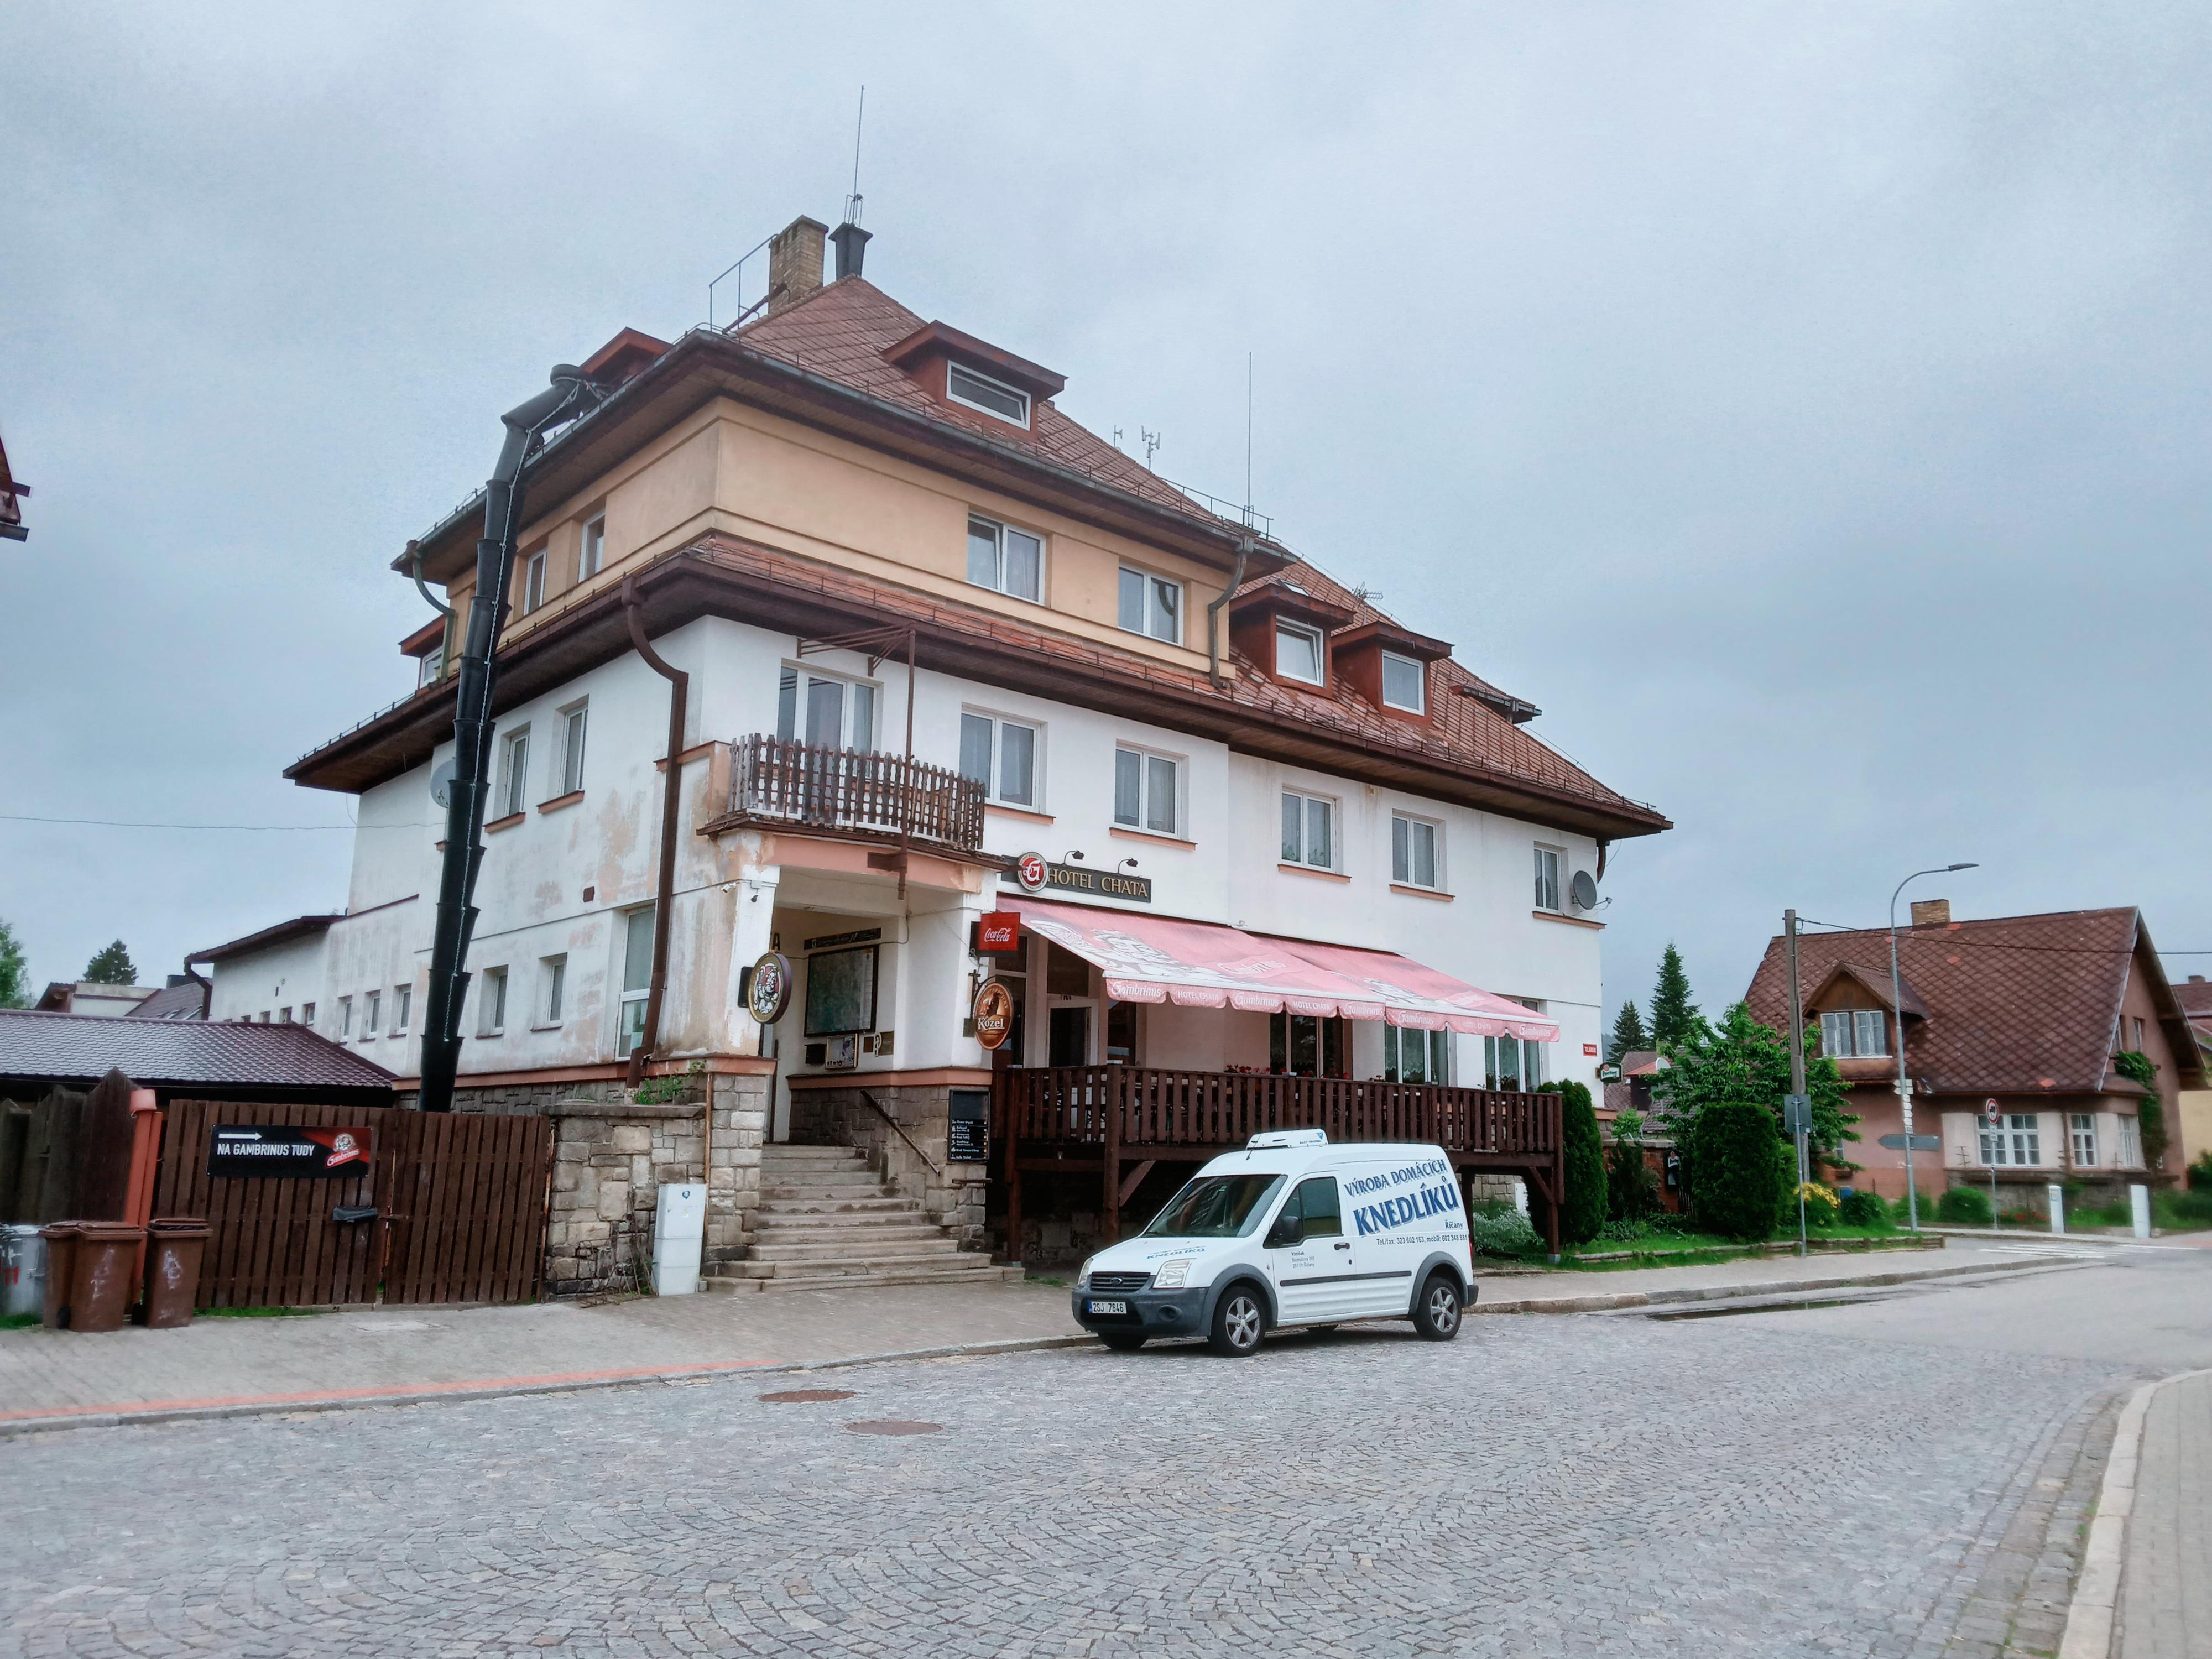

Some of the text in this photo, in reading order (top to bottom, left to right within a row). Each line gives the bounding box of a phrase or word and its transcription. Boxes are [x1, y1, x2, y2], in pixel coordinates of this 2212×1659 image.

[1048, 868, 1095, 889] HOTEL
[1101, 877, 1148, 898] CHATA
[1112, 981, 1161, 998] Gambrinus
[1178, 991, 1219, 1000] HOTEL CHATA
[1235, 993, 1279, 1007] Gambrinus
[1344, 1002, 1383, 1015] Gambrinus
[978, 1018, 1005, 1031] Kozel
[1398, 1011, 1433, 1025] Gambrinus
[1519, 1024, 1551, 1037] Gambrinus
[217, 1143, 315, 1156] NA GAMBRINUS TUDY
[327, 1149, 359, 1166] Gambrinus
[1344, 1159, 1448, 1197] VÝROBA DOMÁCÍCH
[1353, 1176, 1460, 1237] KNEDLÍKŮ
[1093, 1303, 1104, 1312] 2SJ
